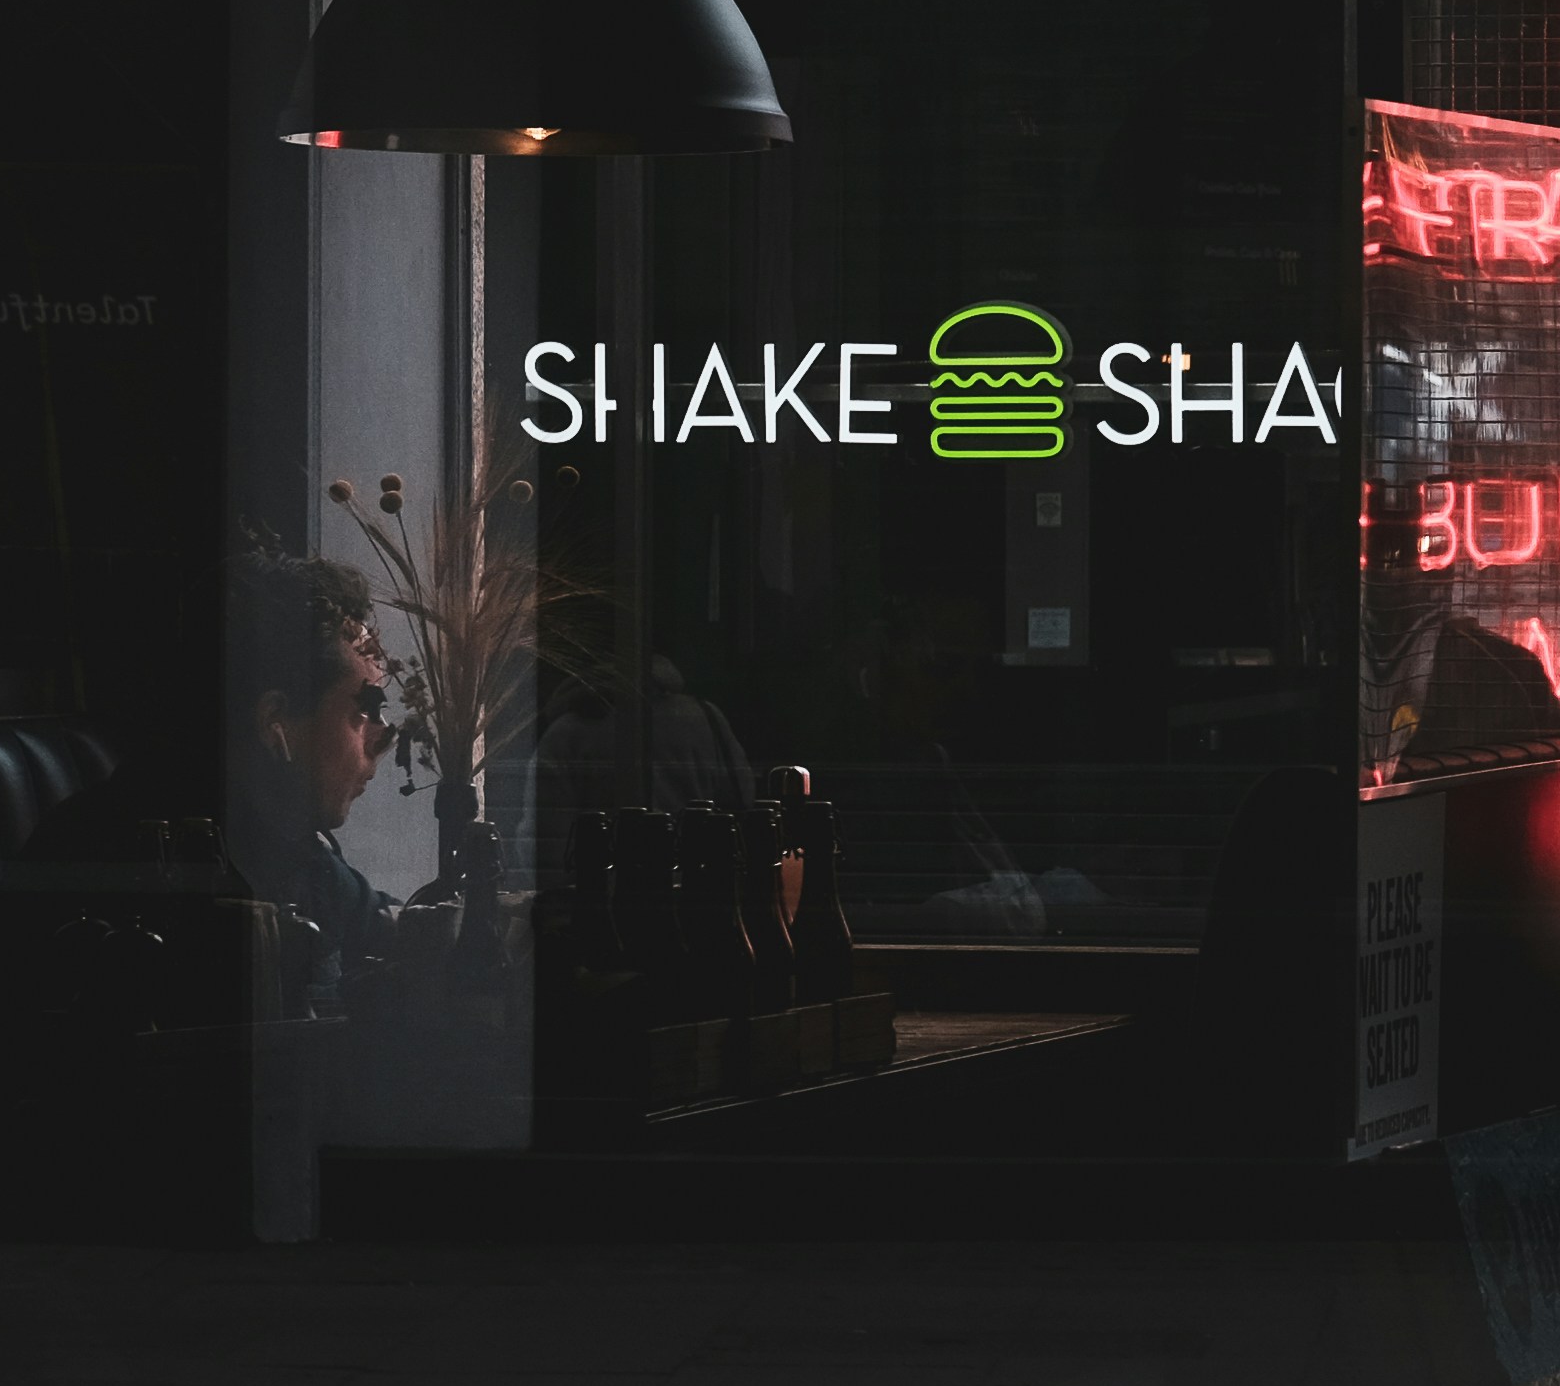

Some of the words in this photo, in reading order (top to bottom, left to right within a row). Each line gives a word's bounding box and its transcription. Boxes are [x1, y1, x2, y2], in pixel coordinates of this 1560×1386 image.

[520, 340, 899, 445] SHAKE
[1096, 340, 1343, 447] SHA
[1367, 871, 1424, 945] PLEASE
[1392, 945, 1412, 1011] TO
[1413, 940, 1435, 1004] BE
[1366, 1015, 1420, 1089] SEATED
